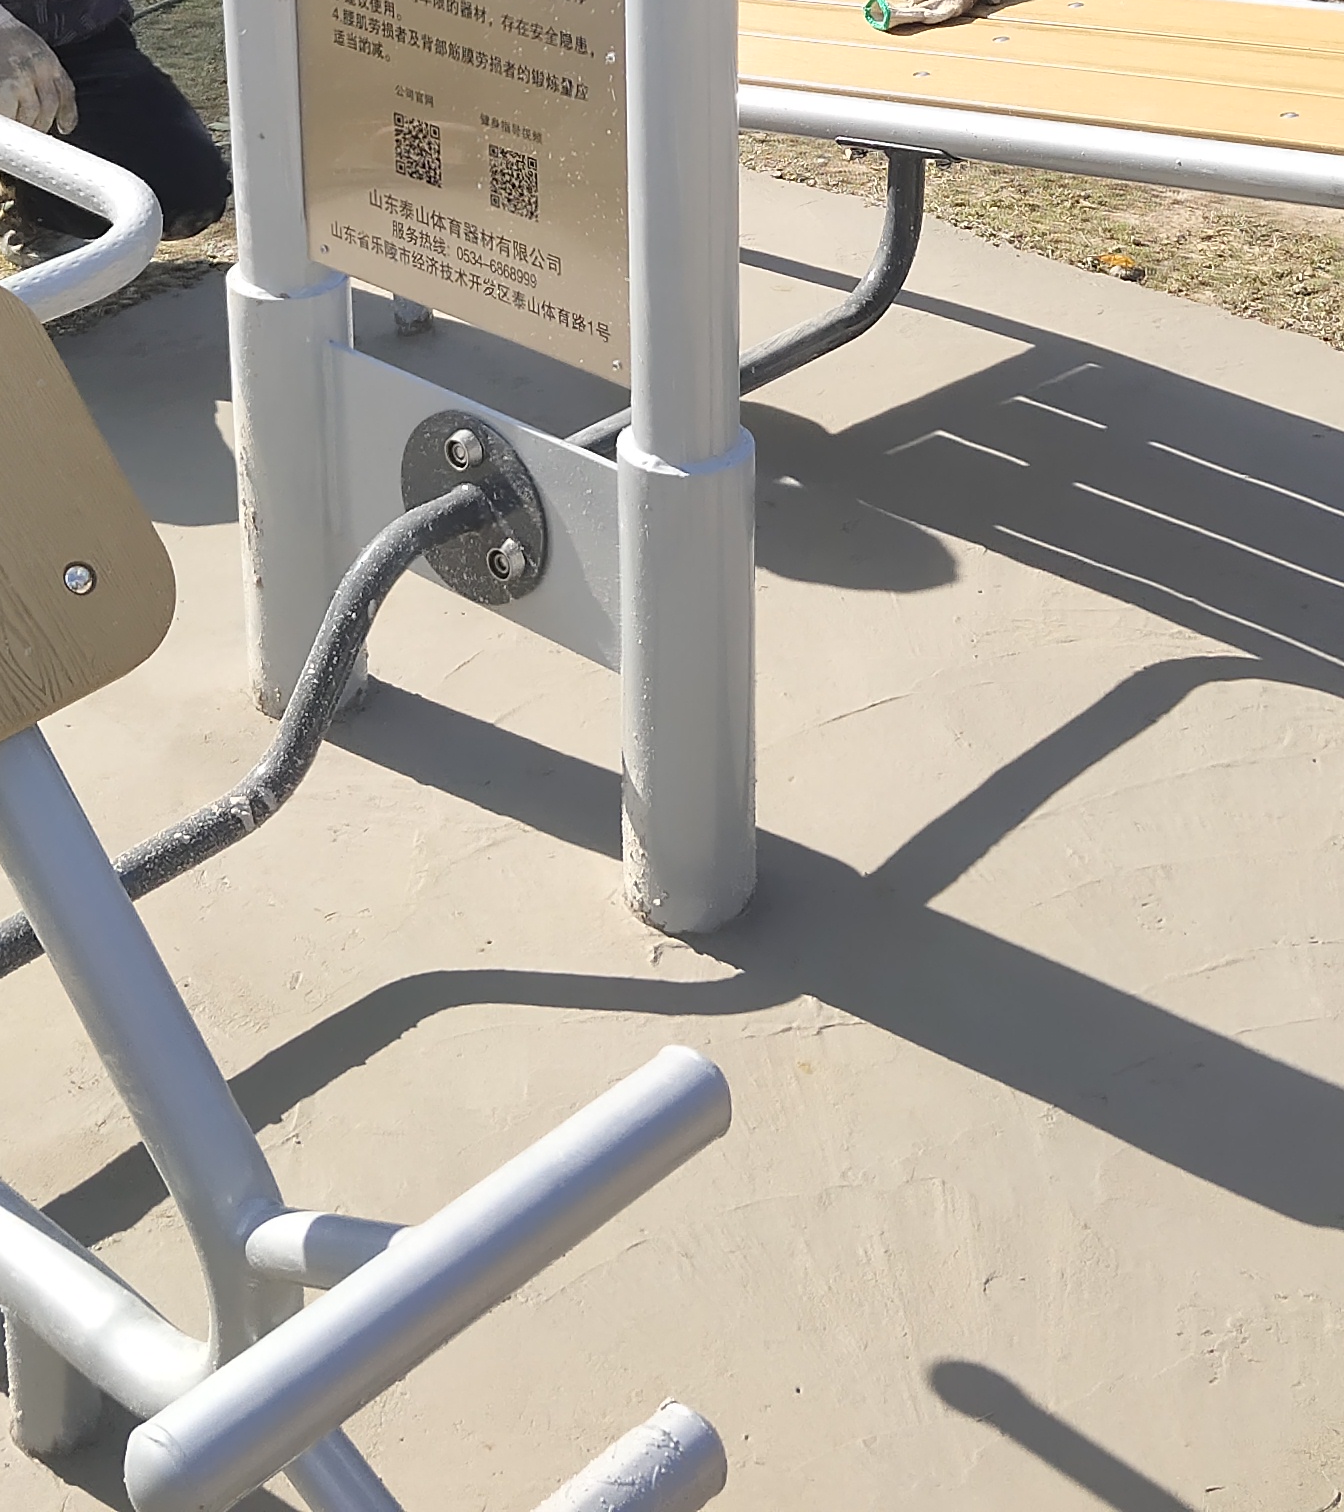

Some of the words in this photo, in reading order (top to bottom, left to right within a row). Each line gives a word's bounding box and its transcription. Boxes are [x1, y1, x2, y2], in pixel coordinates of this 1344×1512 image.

[395, 84, 434, 109] 公司官网
[480, 112, 544, 146] 健身指导视频
[369, 188, 562, 277] 山东泰山体育器材有限公司
[331, 220, 611, 344] 山东省乐陵市经济技术开发区泰山体育路1号
